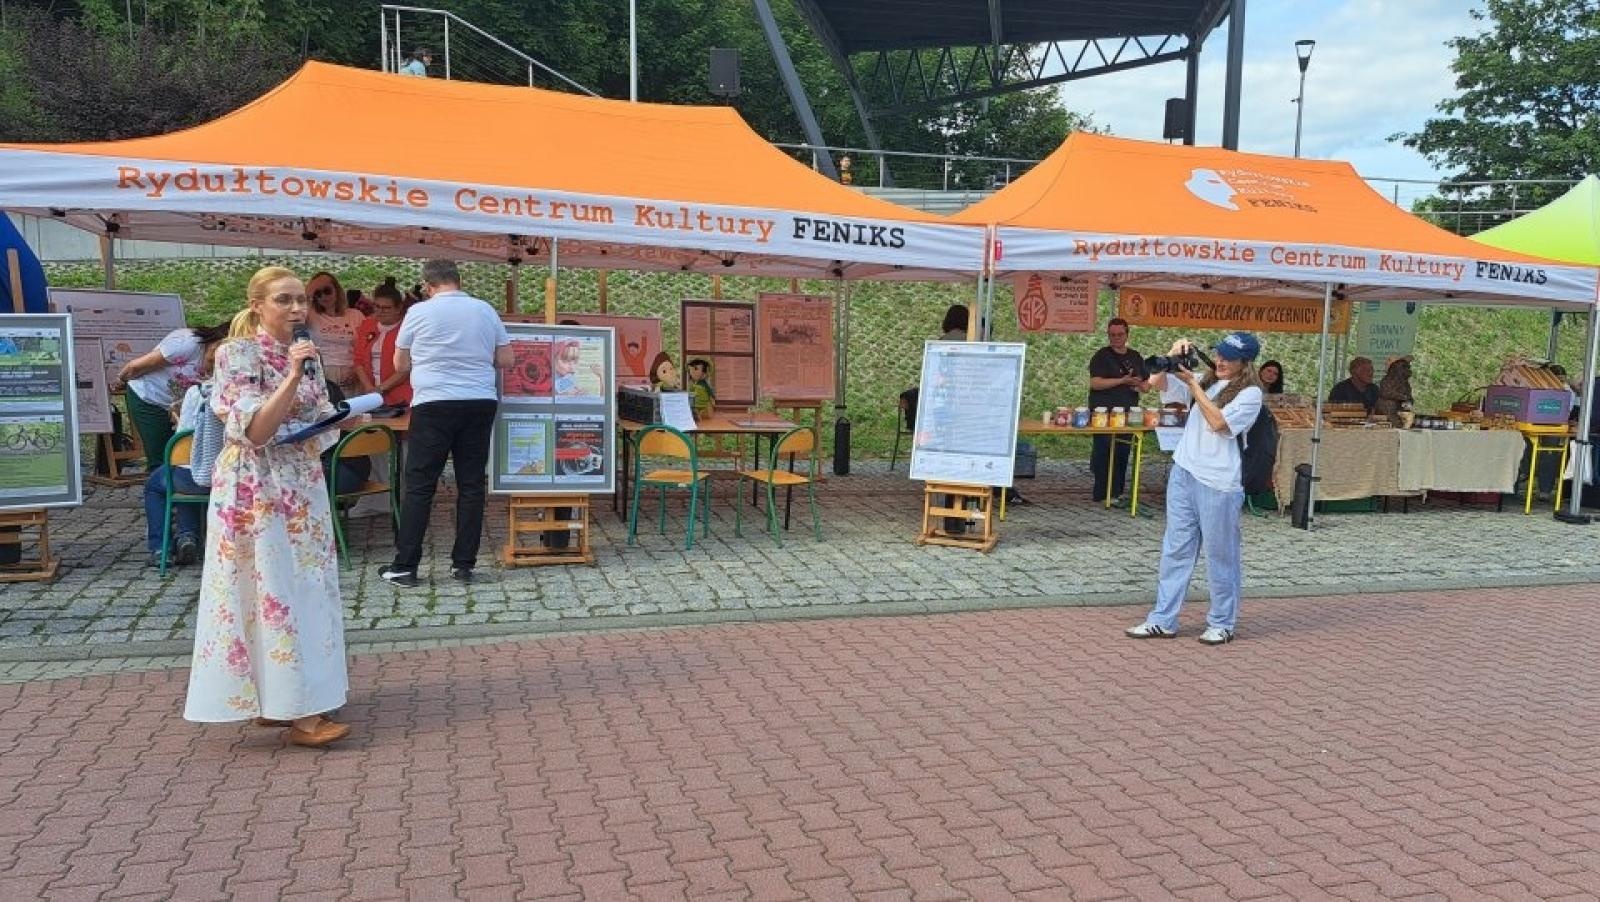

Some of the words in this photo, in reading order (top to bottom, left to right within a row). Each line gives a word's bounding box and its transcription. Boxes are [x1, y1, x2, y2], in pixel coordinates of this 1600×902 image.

[117, 165, 430, 208] Rydułtowskie
[455, 188, 614, 224] Centrum
[634, 204, 776, 243] Kultury
[792, 217, 906, 249] FENIKS
[1072, 239, 1255, 263] Rydułtowskie
[1270, 246, 1367, 270] Centrum
[1379, 254, 1466, 282] Kultury
[1475, 261, 1548, 285] FENIKS
[1152, 300, 1179, 318] KOŁO
[1182, 302, 1253, 322] PSZCZELARZY
[1254, 306, 1266, 323] W
[1267, 306, 1318, 325] CZERNICY
